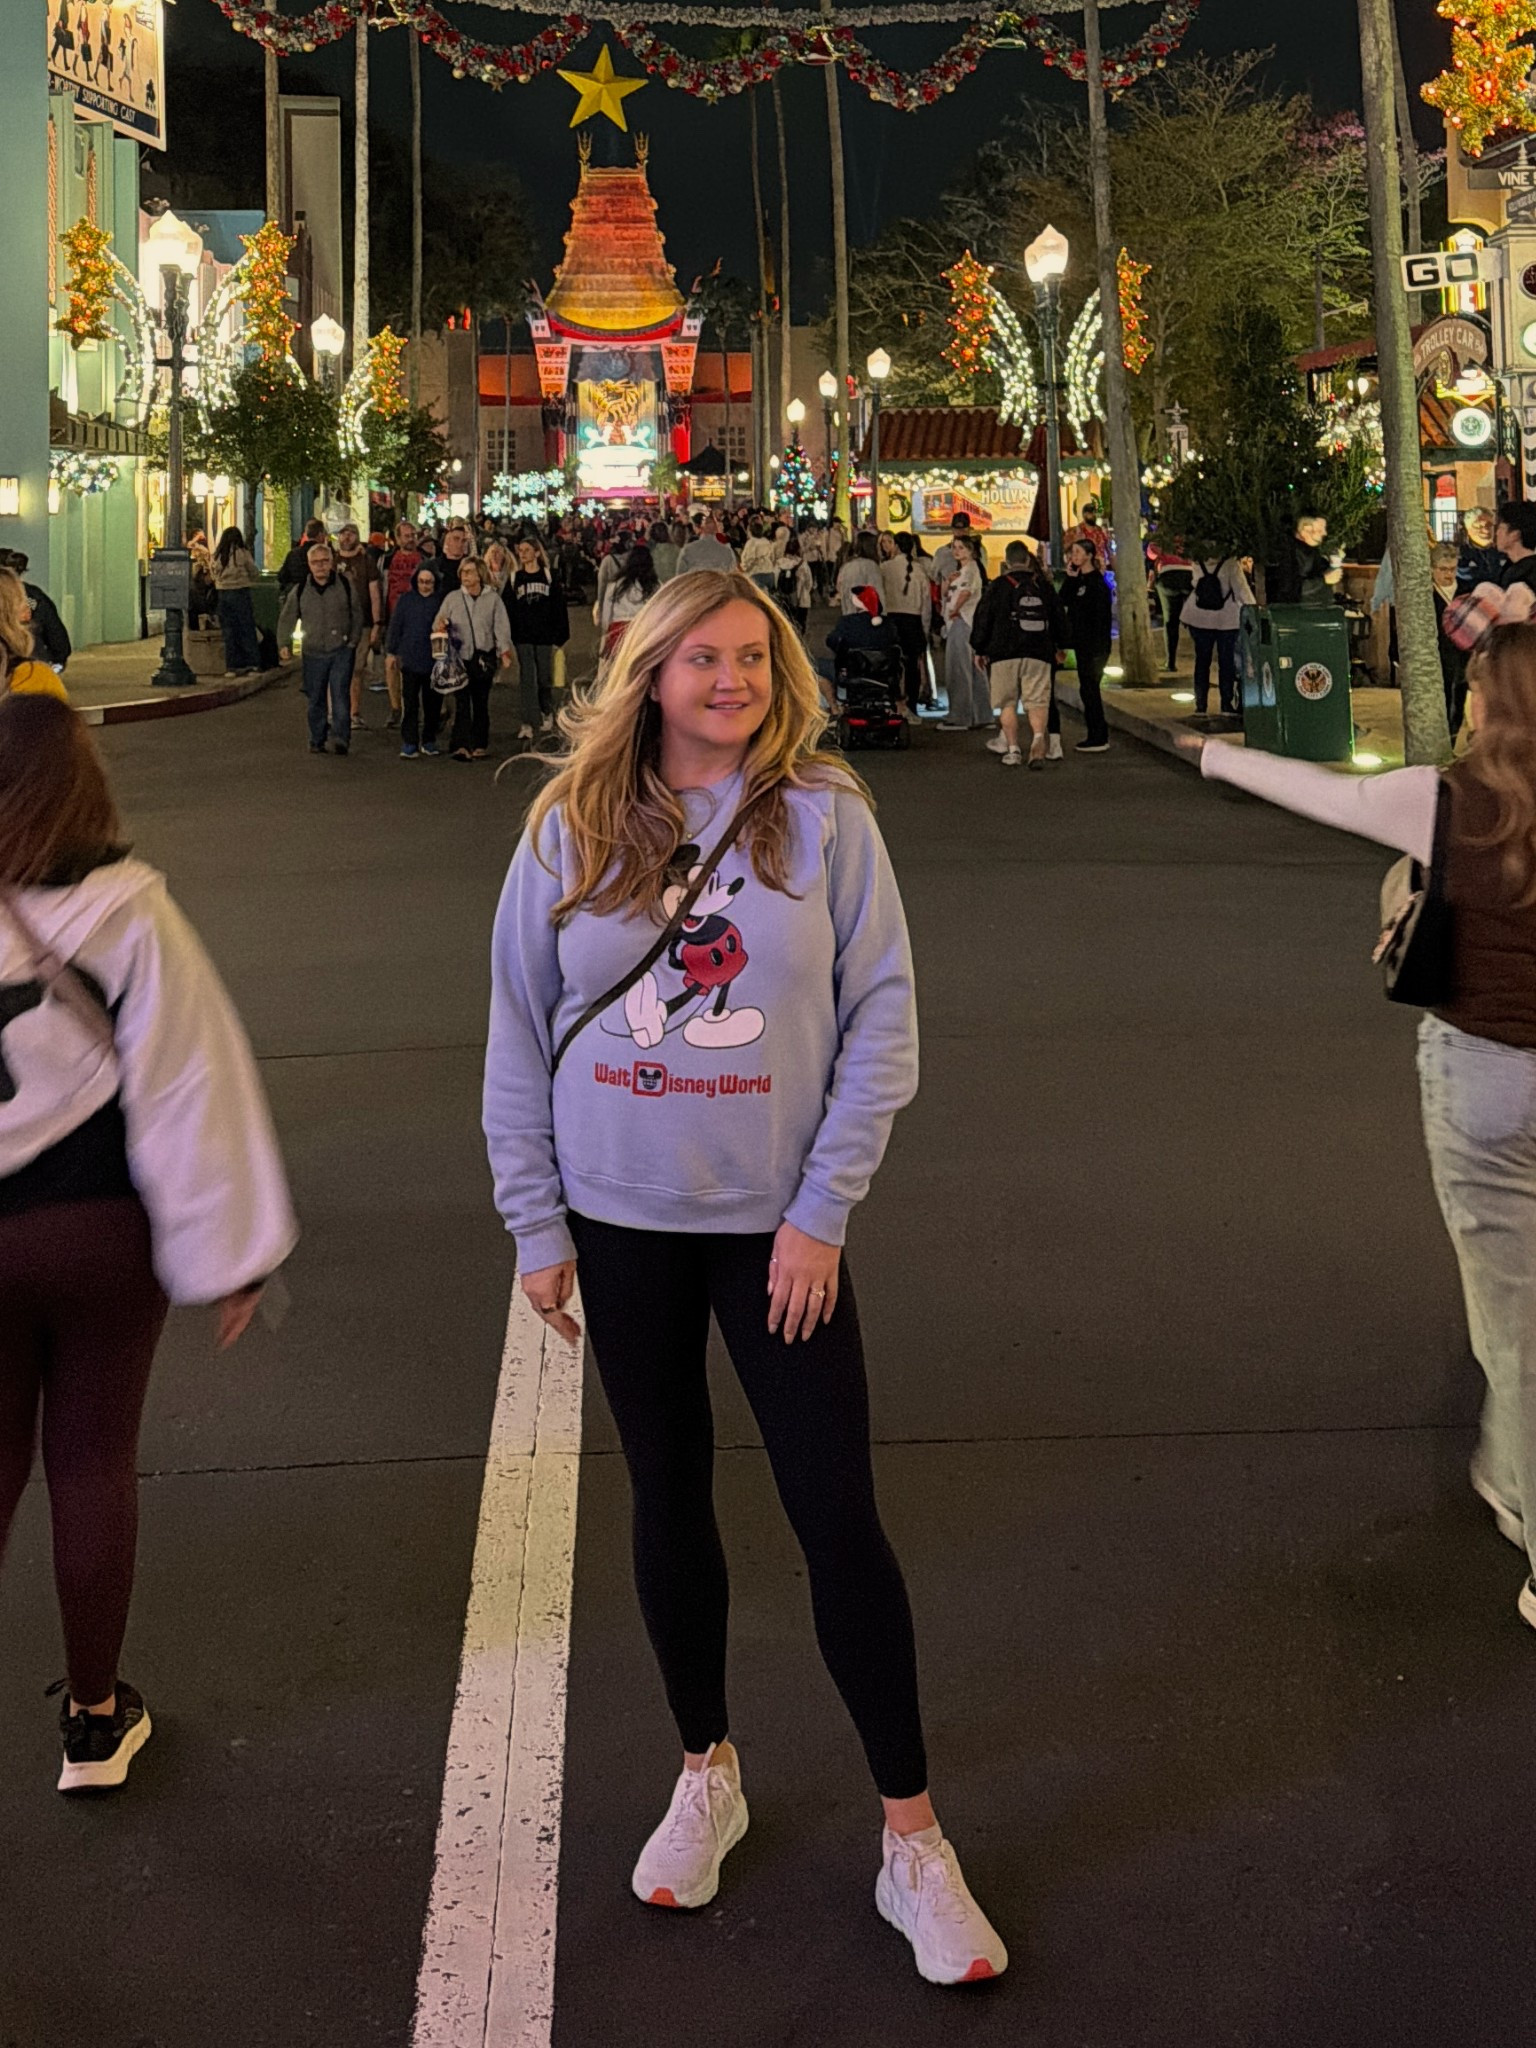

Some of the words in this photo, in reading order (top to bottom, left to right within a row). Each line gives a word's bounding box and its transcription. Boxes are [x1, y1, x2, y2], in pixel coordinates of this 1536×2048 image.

[82, 88, 118, 116] SUPPORTING
[120, 106, 136, 123] CAST
[1498, 172, 1530, 186] VINE
[1406, 252, 1478, 287] GO
[1420, 327, 1455, 359] TROLLEY
[1456, 328, 1475, 349] CAR
[594, 1062, 630, 1088] Walt
[719, 1074, 772, 1095] World
